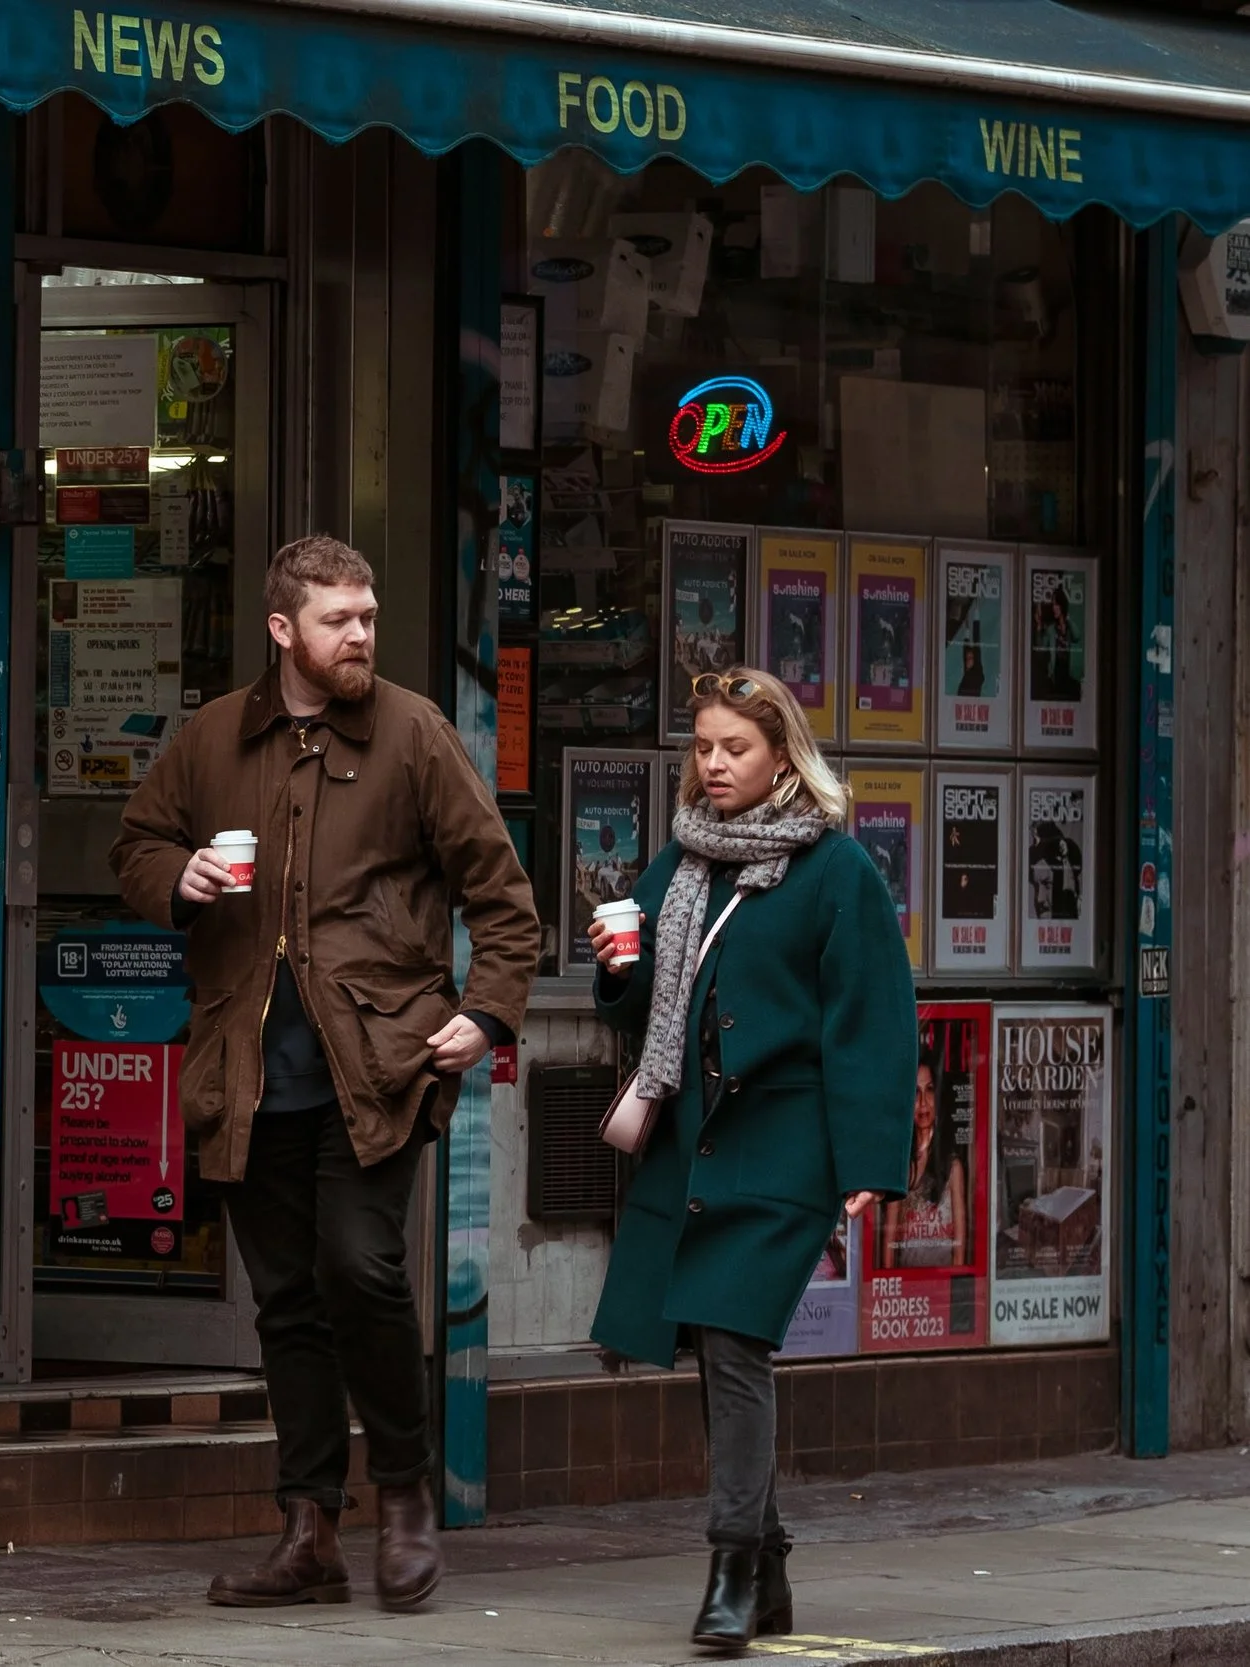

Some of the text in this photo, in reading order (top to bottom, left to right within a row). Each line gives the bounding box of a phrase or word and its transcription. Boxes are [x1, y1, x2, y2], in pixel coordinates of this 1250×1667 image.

[73, 11, 1084, 184] NEWS FOOD WINE
[669, 402, 771, 457] OPEN
[66, 451, 140, 465] UNDER 25?
[672, 534, 743, 549] AUTO ADDICTS
[948, 566, 991, 583] SIGHT
[1033, 573, 1074, 588] SIGHT
[948, 581, 1000, 599] SOUND
[86, 639, 141, 651] OPENING HOURS
[574, 761, 645, 775] AUTO ADDICTS
[945, 789, 986, 805] SIGHT
[1030, 791, 1072, 806] SIGHT
[584, 806, 630, 816] AUTO ADDICTS
[945, 805, 996, 820] SOUND
[1030, 806, 1081, 822] SOUND
[62, 951, 83, 965] 18+
[101, 944, 122, 952] FROM
[154, 943, 172, 951] 2021
[91, 952, 108, 960] YOU
[150, 953, 160, 961] OR
[161, 953, 182, 961] OVER
[102, 961, 172, 969] TO PLAY NATIONAL
[141, 970, 168, 978] GAMES
[1002, 1024, 1101, 1066] HOUSE
[61, 1051, 154, 1083] UNDER
[60, 1082, 105, 1111] 25?
[60, 1116, 110, 1128] Please be
[60, 1134, 149, 1148] prepared to show
[59, 1152, 150, 1167] proof of age when
[59, 1170, 131, 1184] buying alcohol
[58, 1236, 122, 1246] drinkaware.co.uk
[871, 1276, 903, 1298] FREE
[871, 1296, 930, 1318] ADDRESS
[995, 1295, 1101, 1322] ON SALE NOW
[871, 1316, 944, 1340] BOOK 2023
